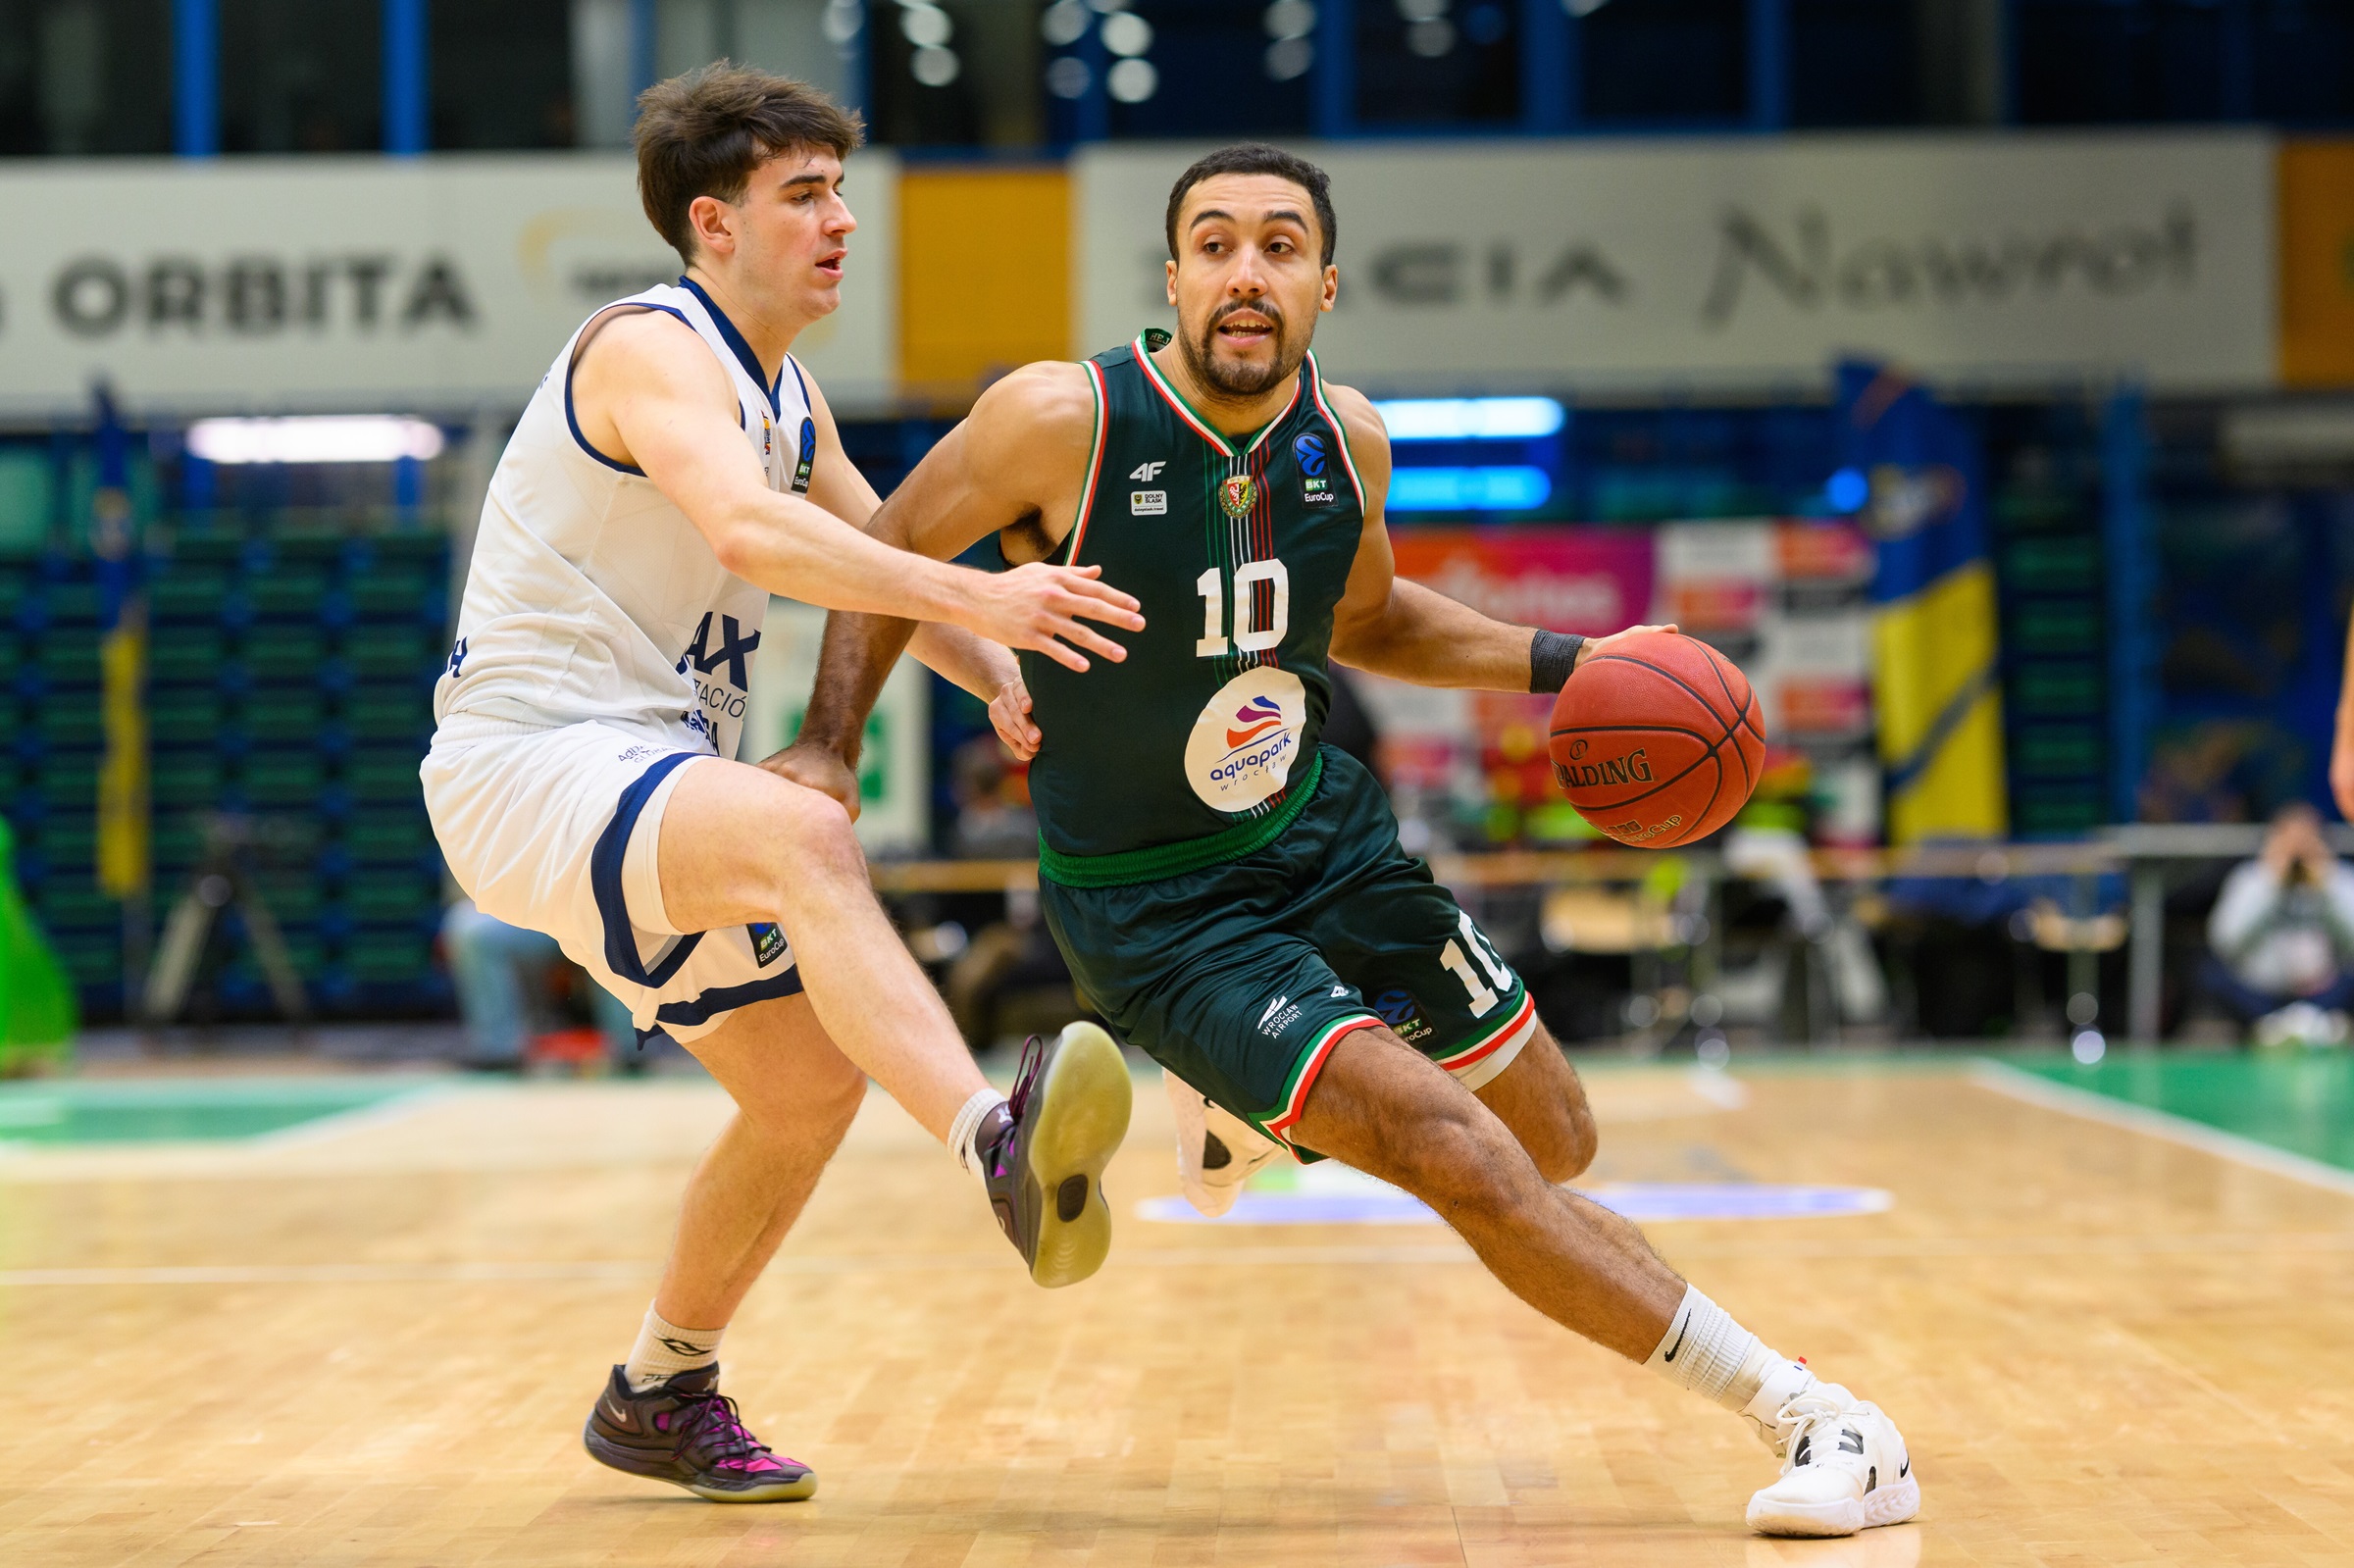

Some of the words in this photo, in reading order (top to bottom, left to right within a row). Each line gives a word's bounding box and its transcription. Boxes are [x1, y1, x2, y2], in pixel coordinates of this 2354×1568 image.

[54, 255, 476, 334] ORBITA
[1129, 461, 1166, 481] 4F
[1305, 480, 1326, 489] BKT
[1305, 492, 1334, 502] EuroCup
[1196, 558, 1289, 658] 10
[677, 612, 761, 692] AX
[1209, 732, 1292, 781] aquapark
[1551, 747, 1654, 789] PALDING
[759, 937, 785, 962] EuroCup
[760, 928, 777, 946] BKT
[1261, 1003, 1299, 1036] WROCLAW
[1271, 1010, 1303, 1039] AIRPORT
[1405, 1027, 1432, 1042] roCup
